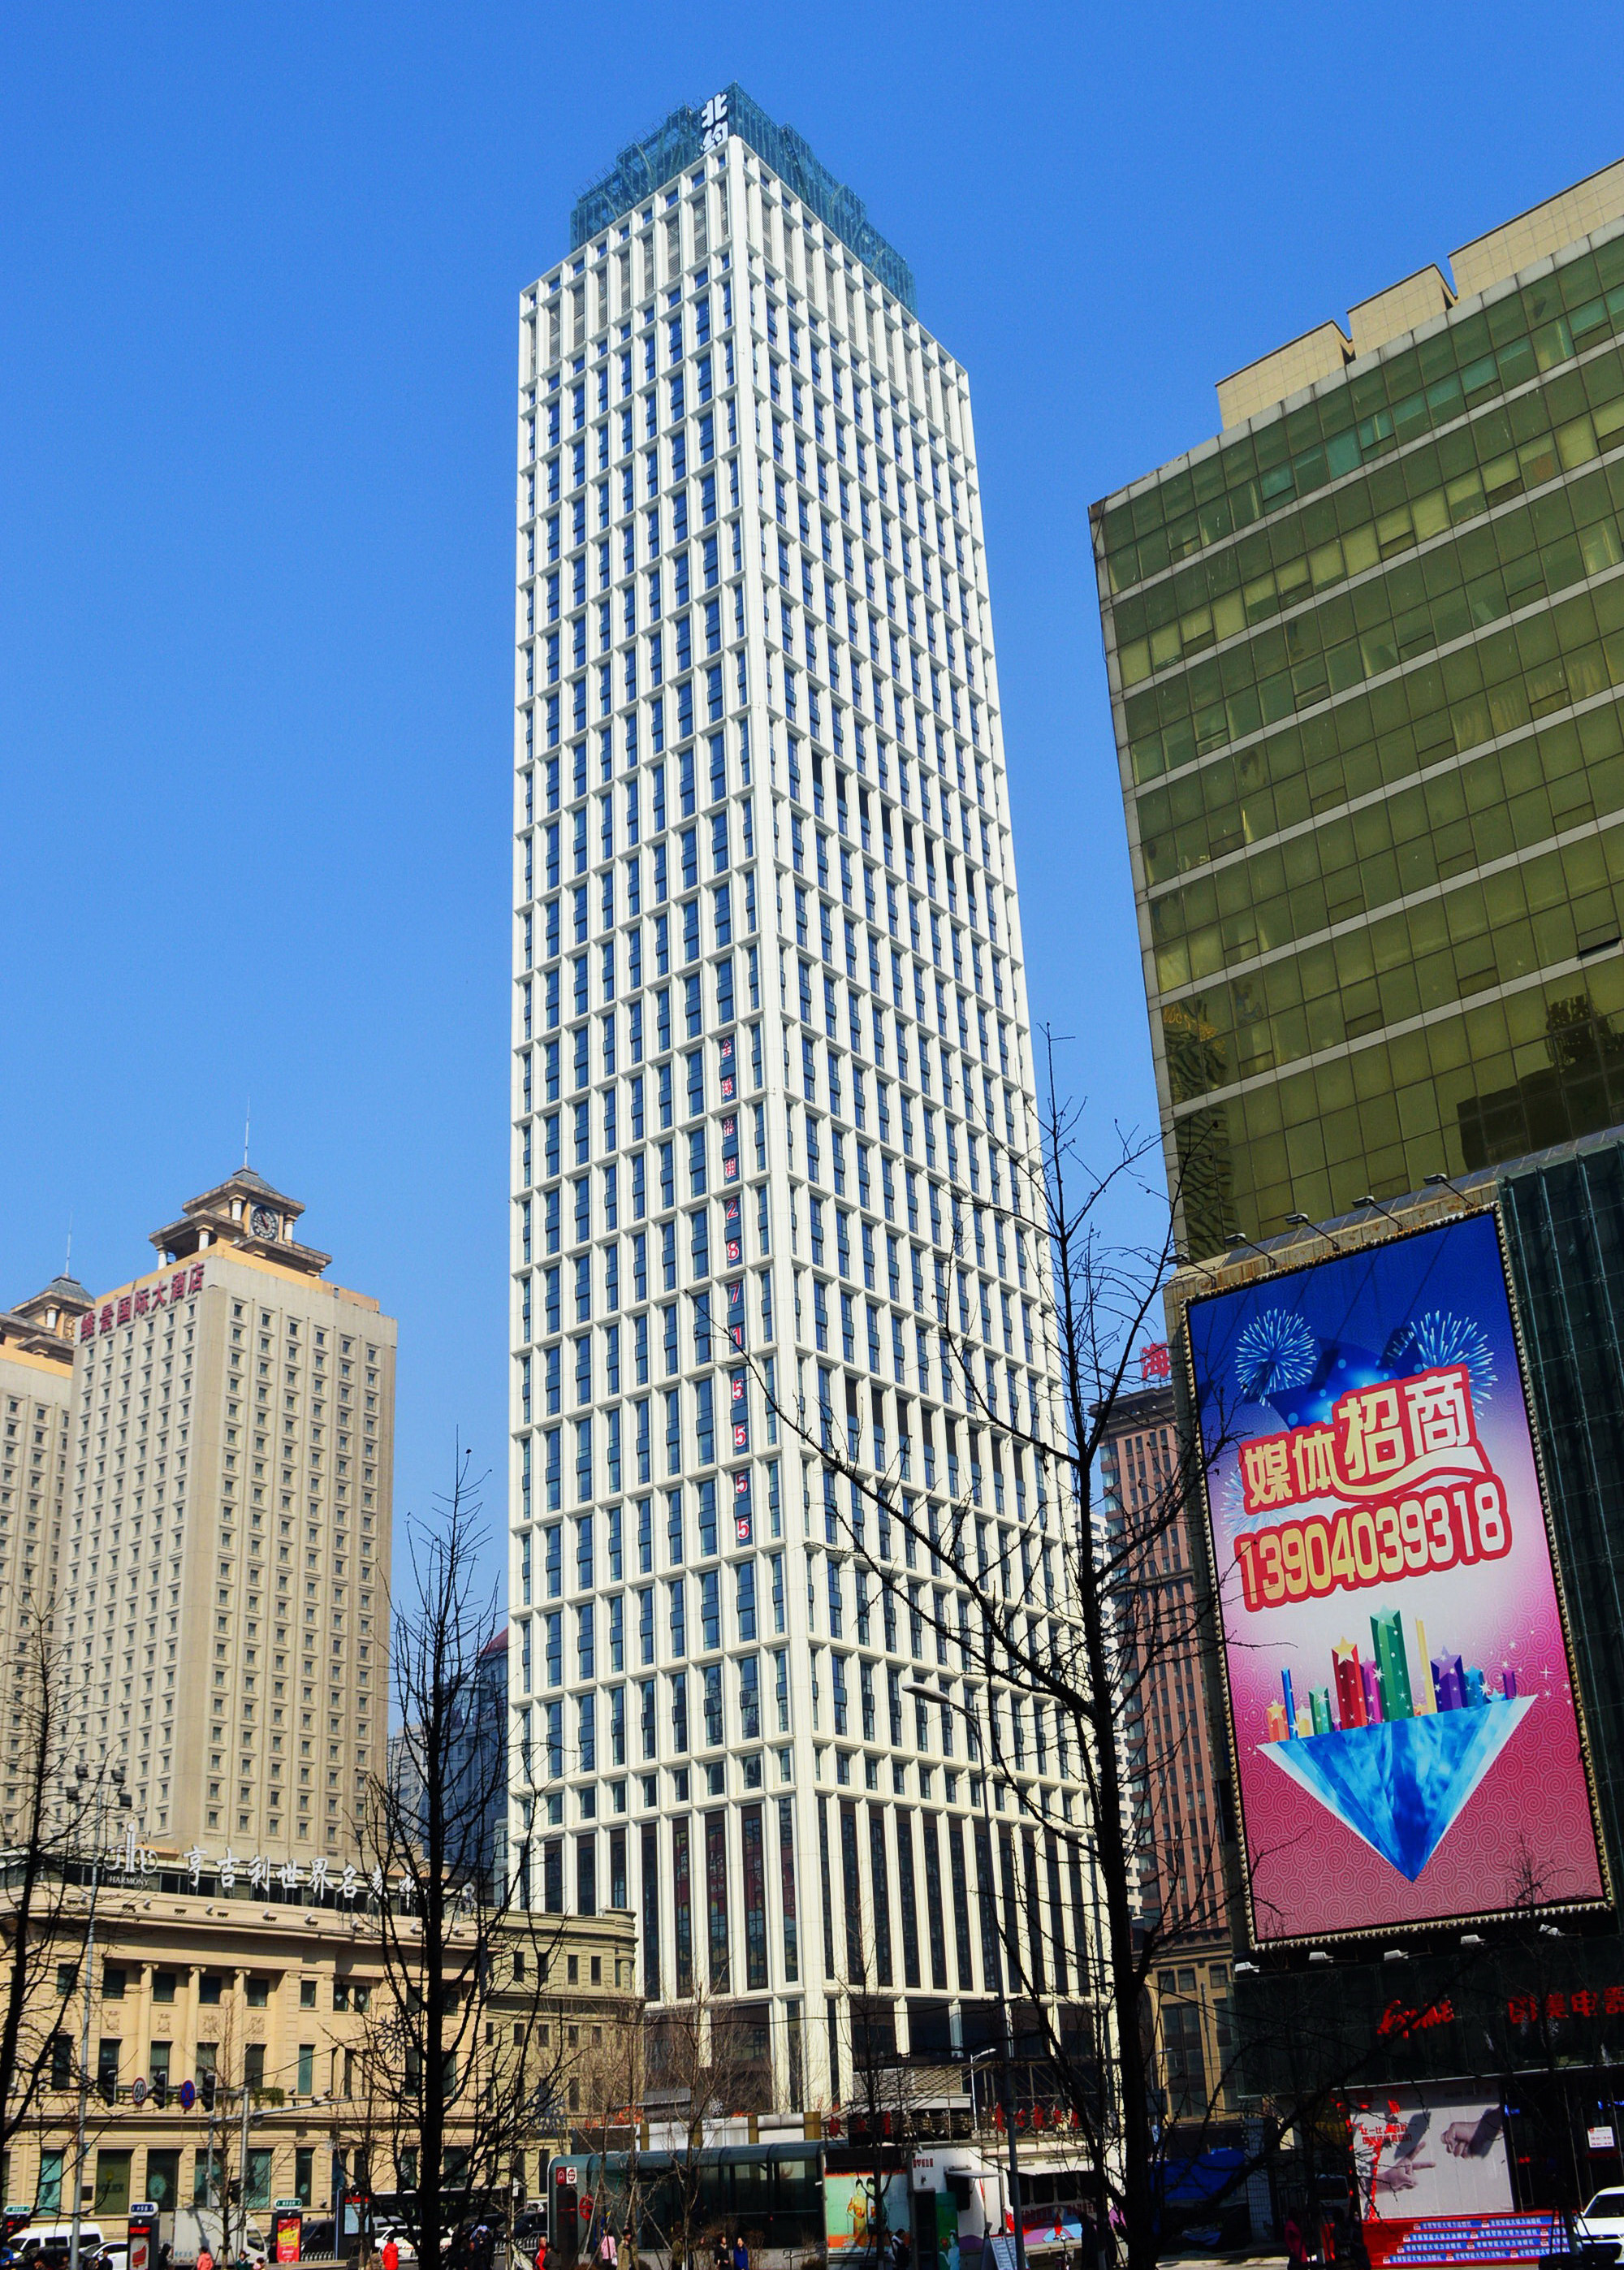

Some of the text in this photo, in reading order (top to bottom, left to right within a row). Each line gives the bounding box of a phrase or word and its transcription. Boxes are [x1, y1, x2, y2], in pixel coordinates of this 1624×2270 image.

[80, 1263, 205, 1343] 维景国际大酒店
[1140, 1342, 1171, 1380] 海
[1245, 1373, 1470, 1507] 媒体招商
[1241, 1482, 1505, 1605] 13904039318
[109, 1875, 149, 1886] HARMONY
